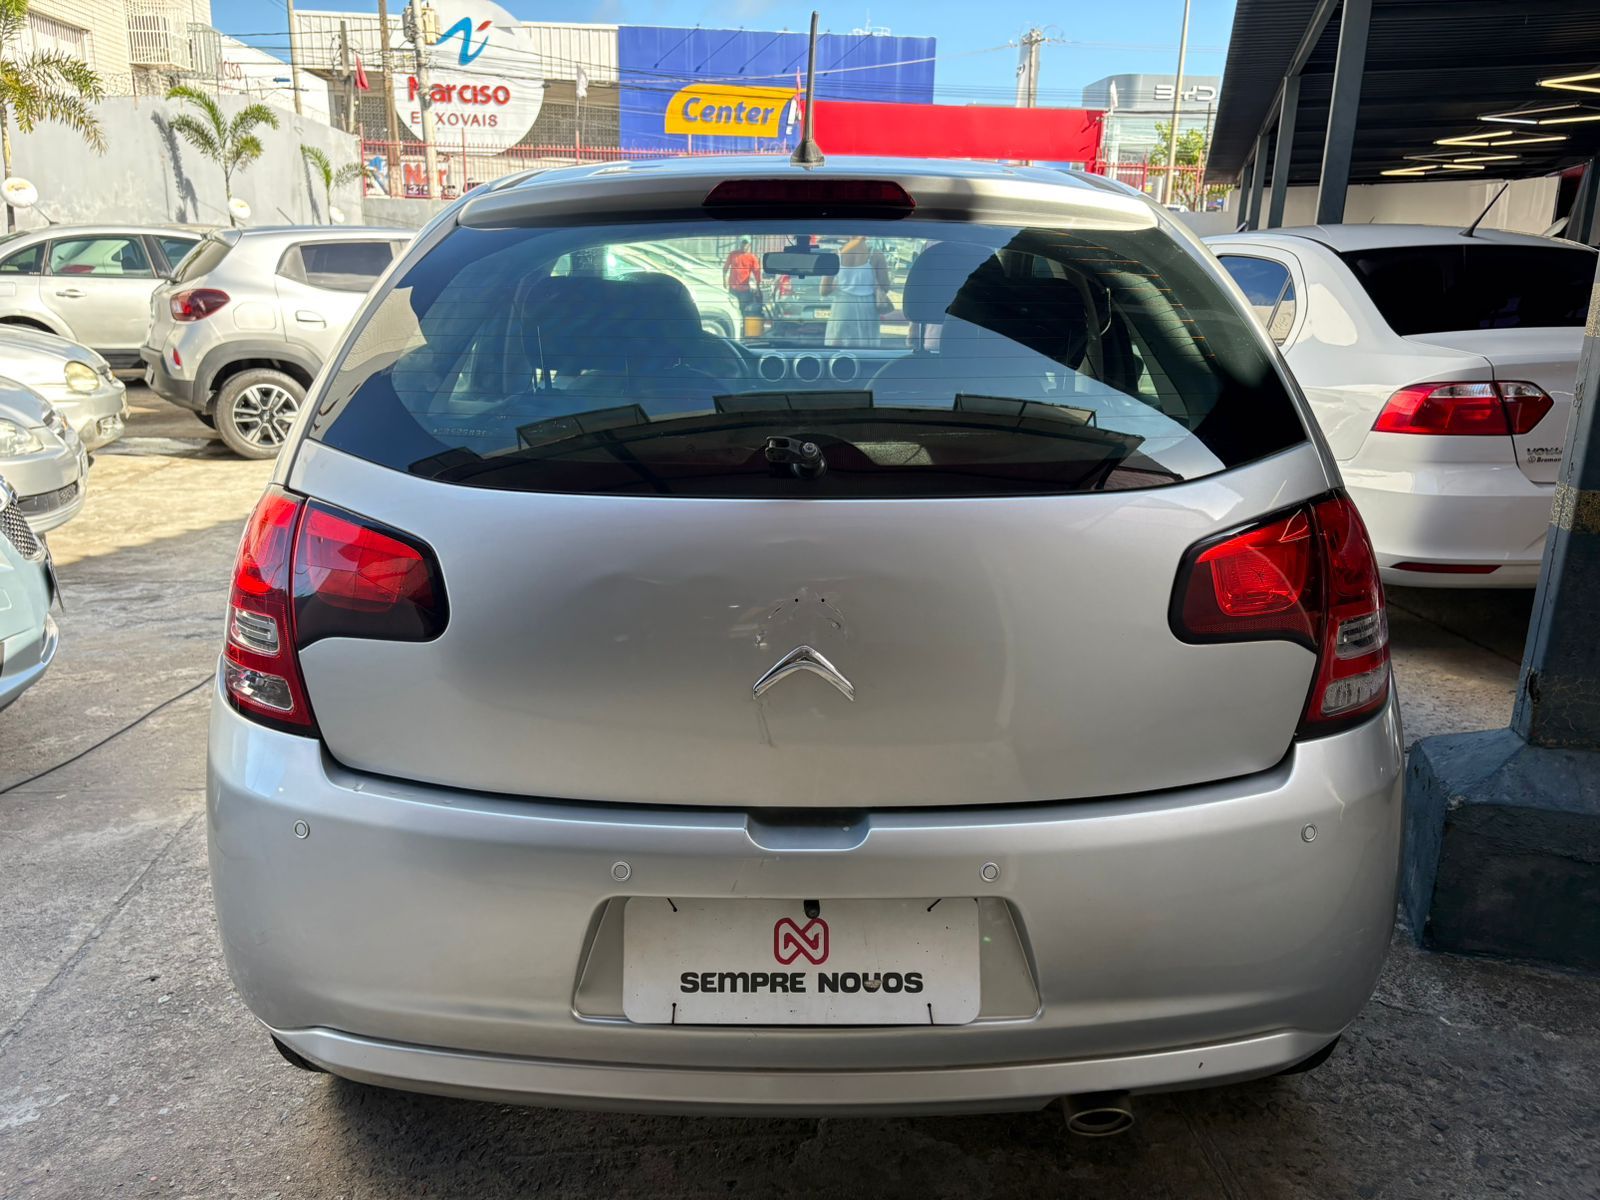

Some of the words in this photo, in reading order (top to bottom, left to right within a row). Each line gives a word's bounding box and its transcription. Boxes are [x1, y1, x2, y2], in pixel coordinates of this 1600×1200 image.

[1154, 84, 1217, 101] BYD
[410, 111, 498, 127] EXOVAIS
[682, 97, 775, 125] Center
[680, 972, 806, 994] SEMPRE
[817, 972, 924, 994] NOVOS
